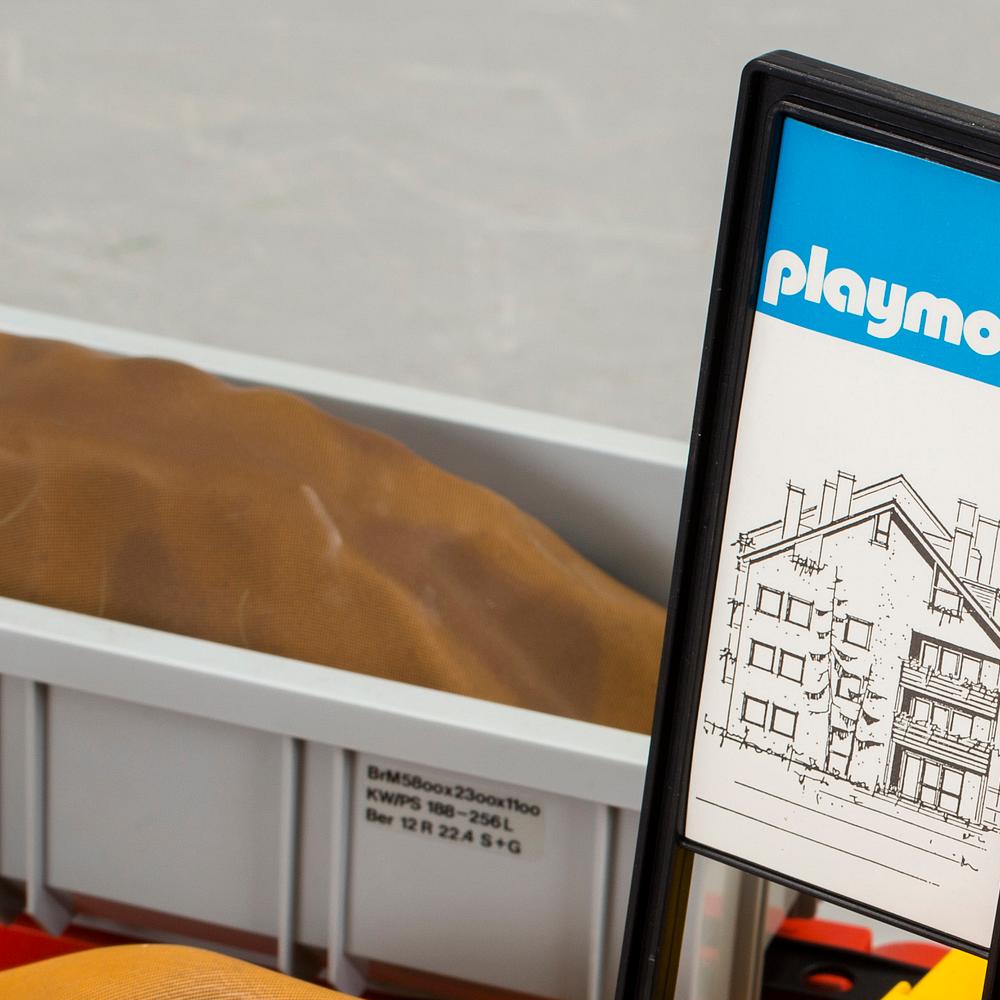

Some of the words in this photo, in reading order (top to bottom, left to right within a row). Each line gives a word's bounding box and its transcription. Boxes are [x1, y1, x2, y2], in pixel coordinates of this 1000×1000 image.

[366, 807, 393, 826] Ber
[401, 816, 417, 832] 12
[421, 820, 433, 835] R
